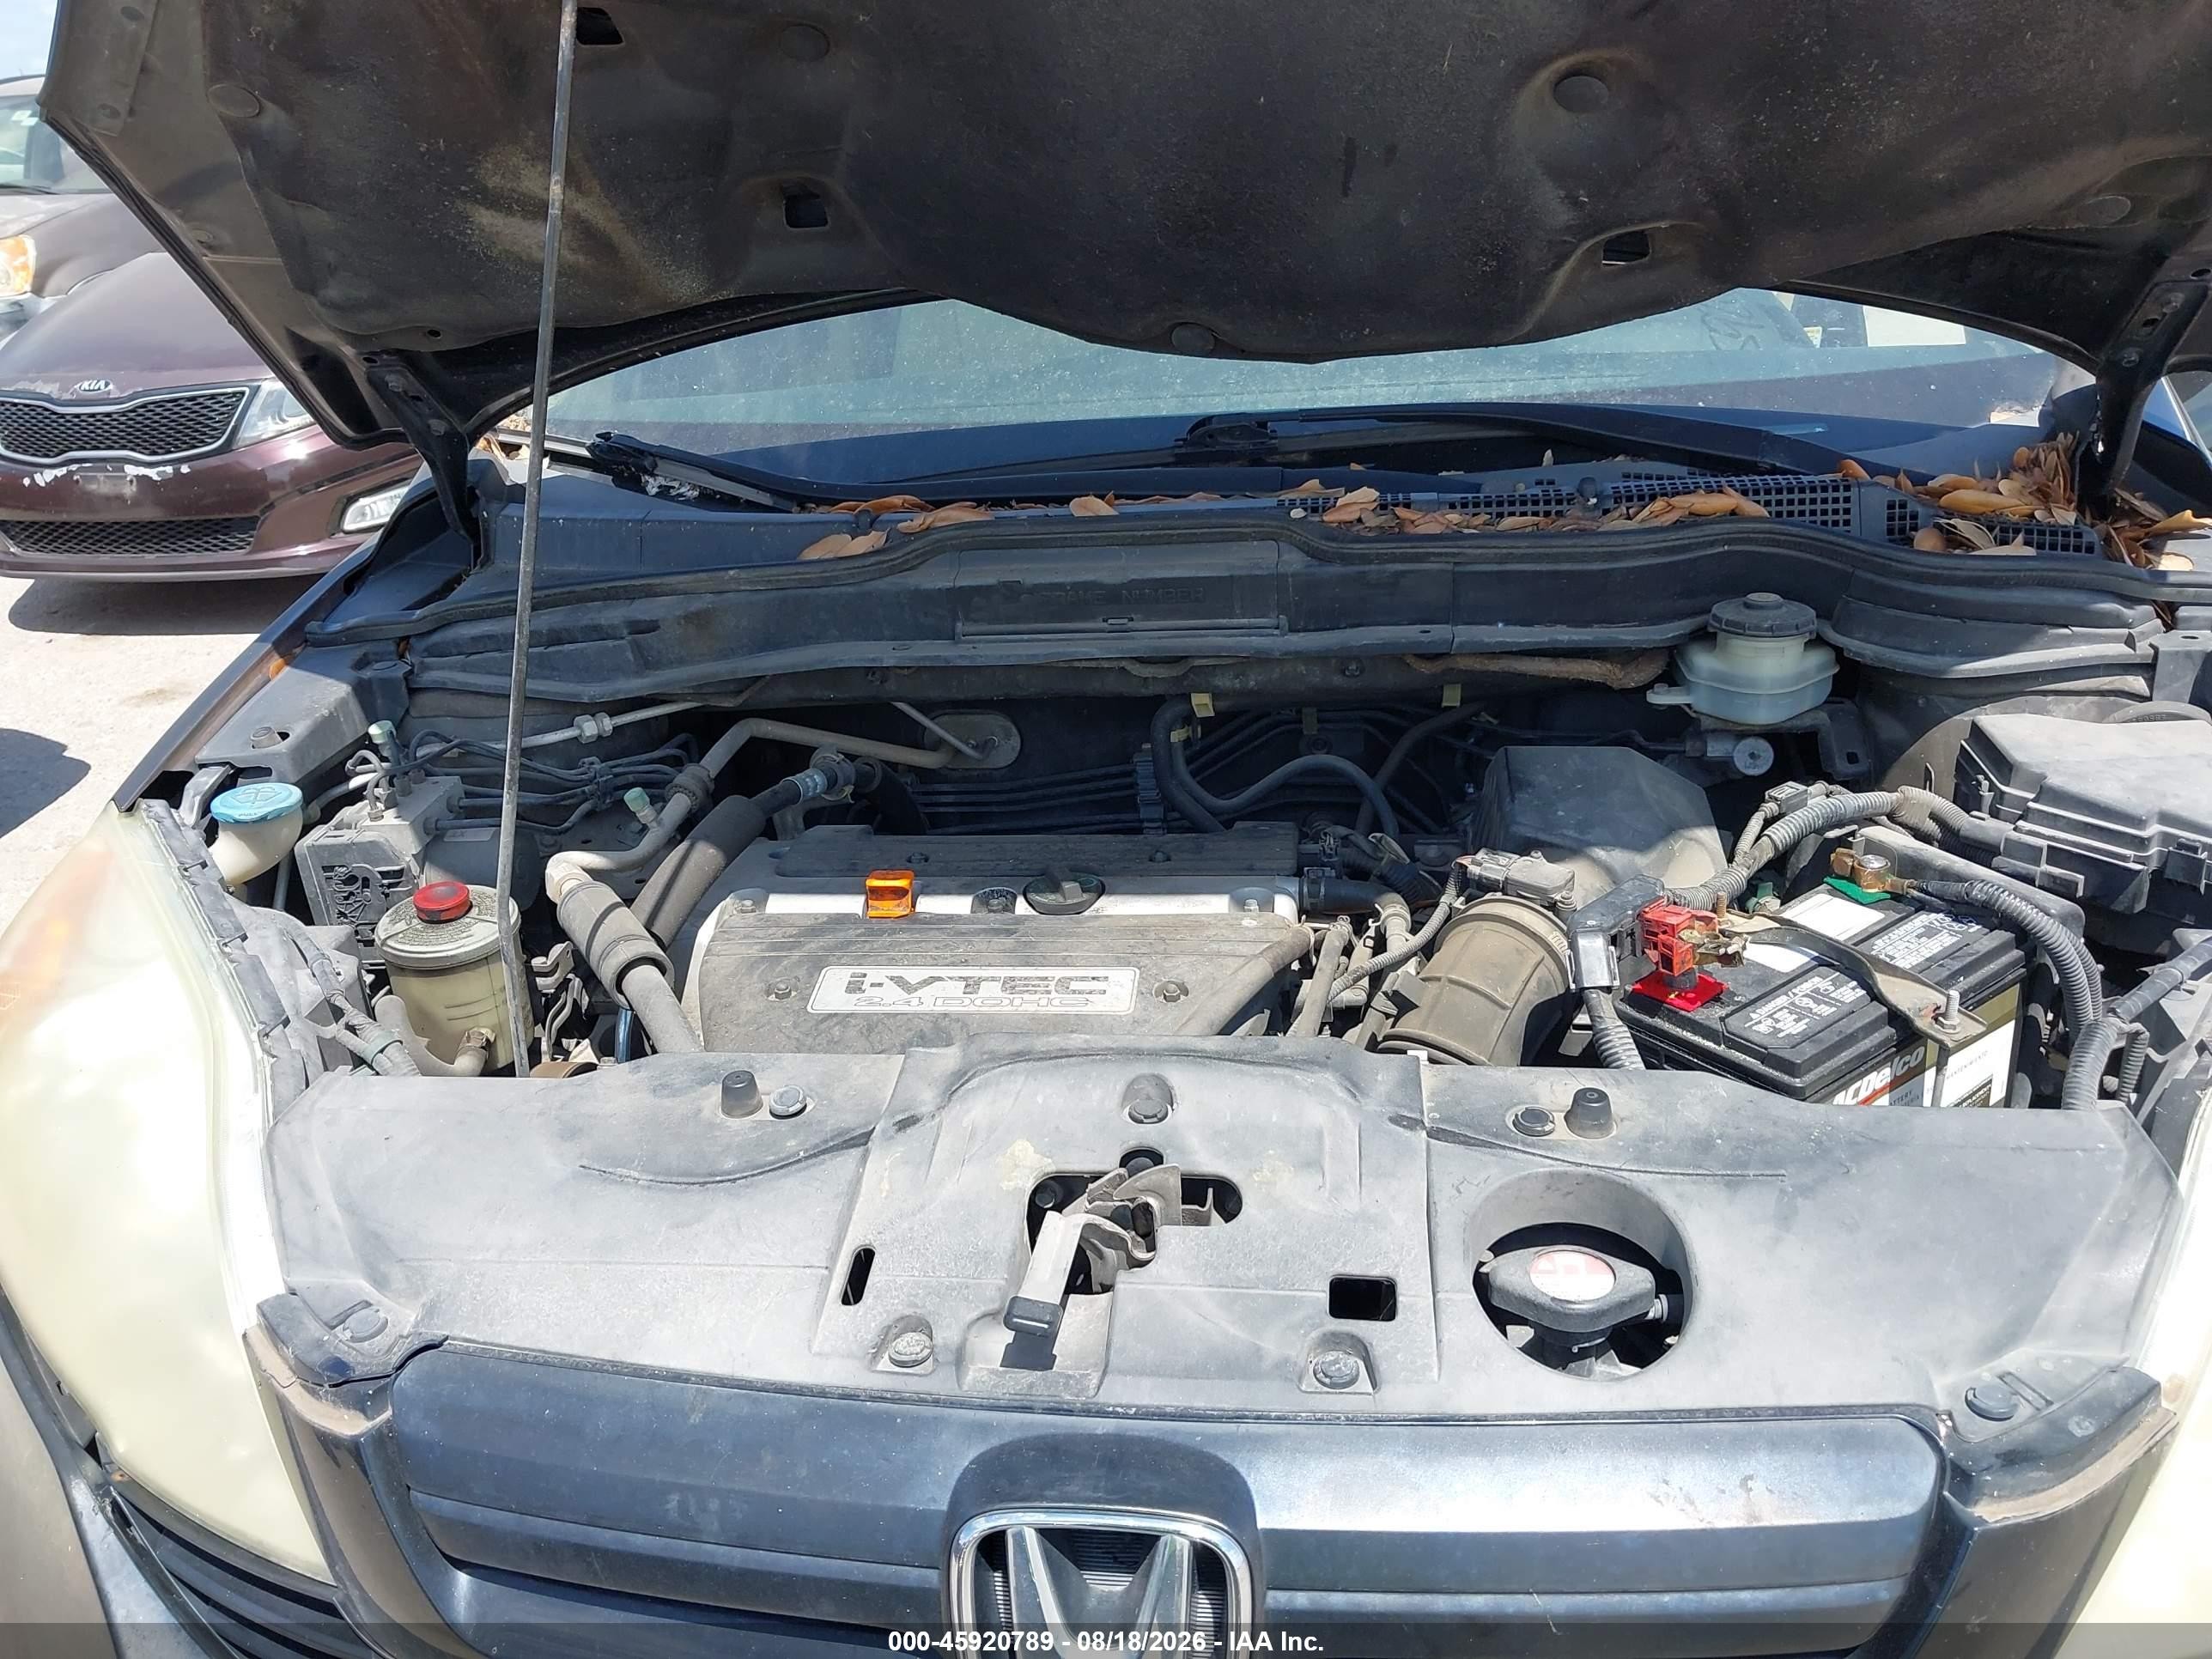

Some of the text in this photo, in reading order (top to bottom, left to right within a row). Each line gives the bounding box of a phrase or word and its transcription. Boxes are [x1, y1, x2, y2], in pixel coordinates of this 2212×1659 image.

[80, 380, 106, 391] KIA
[1121, 587, 1205, 605] NUMBER
[844, 972, 1109, 996] i-VTEC
[854, 996, 1091, 1008] 2.4 DOHC
[1832, 1046, 1925, 1106] ACDelco
